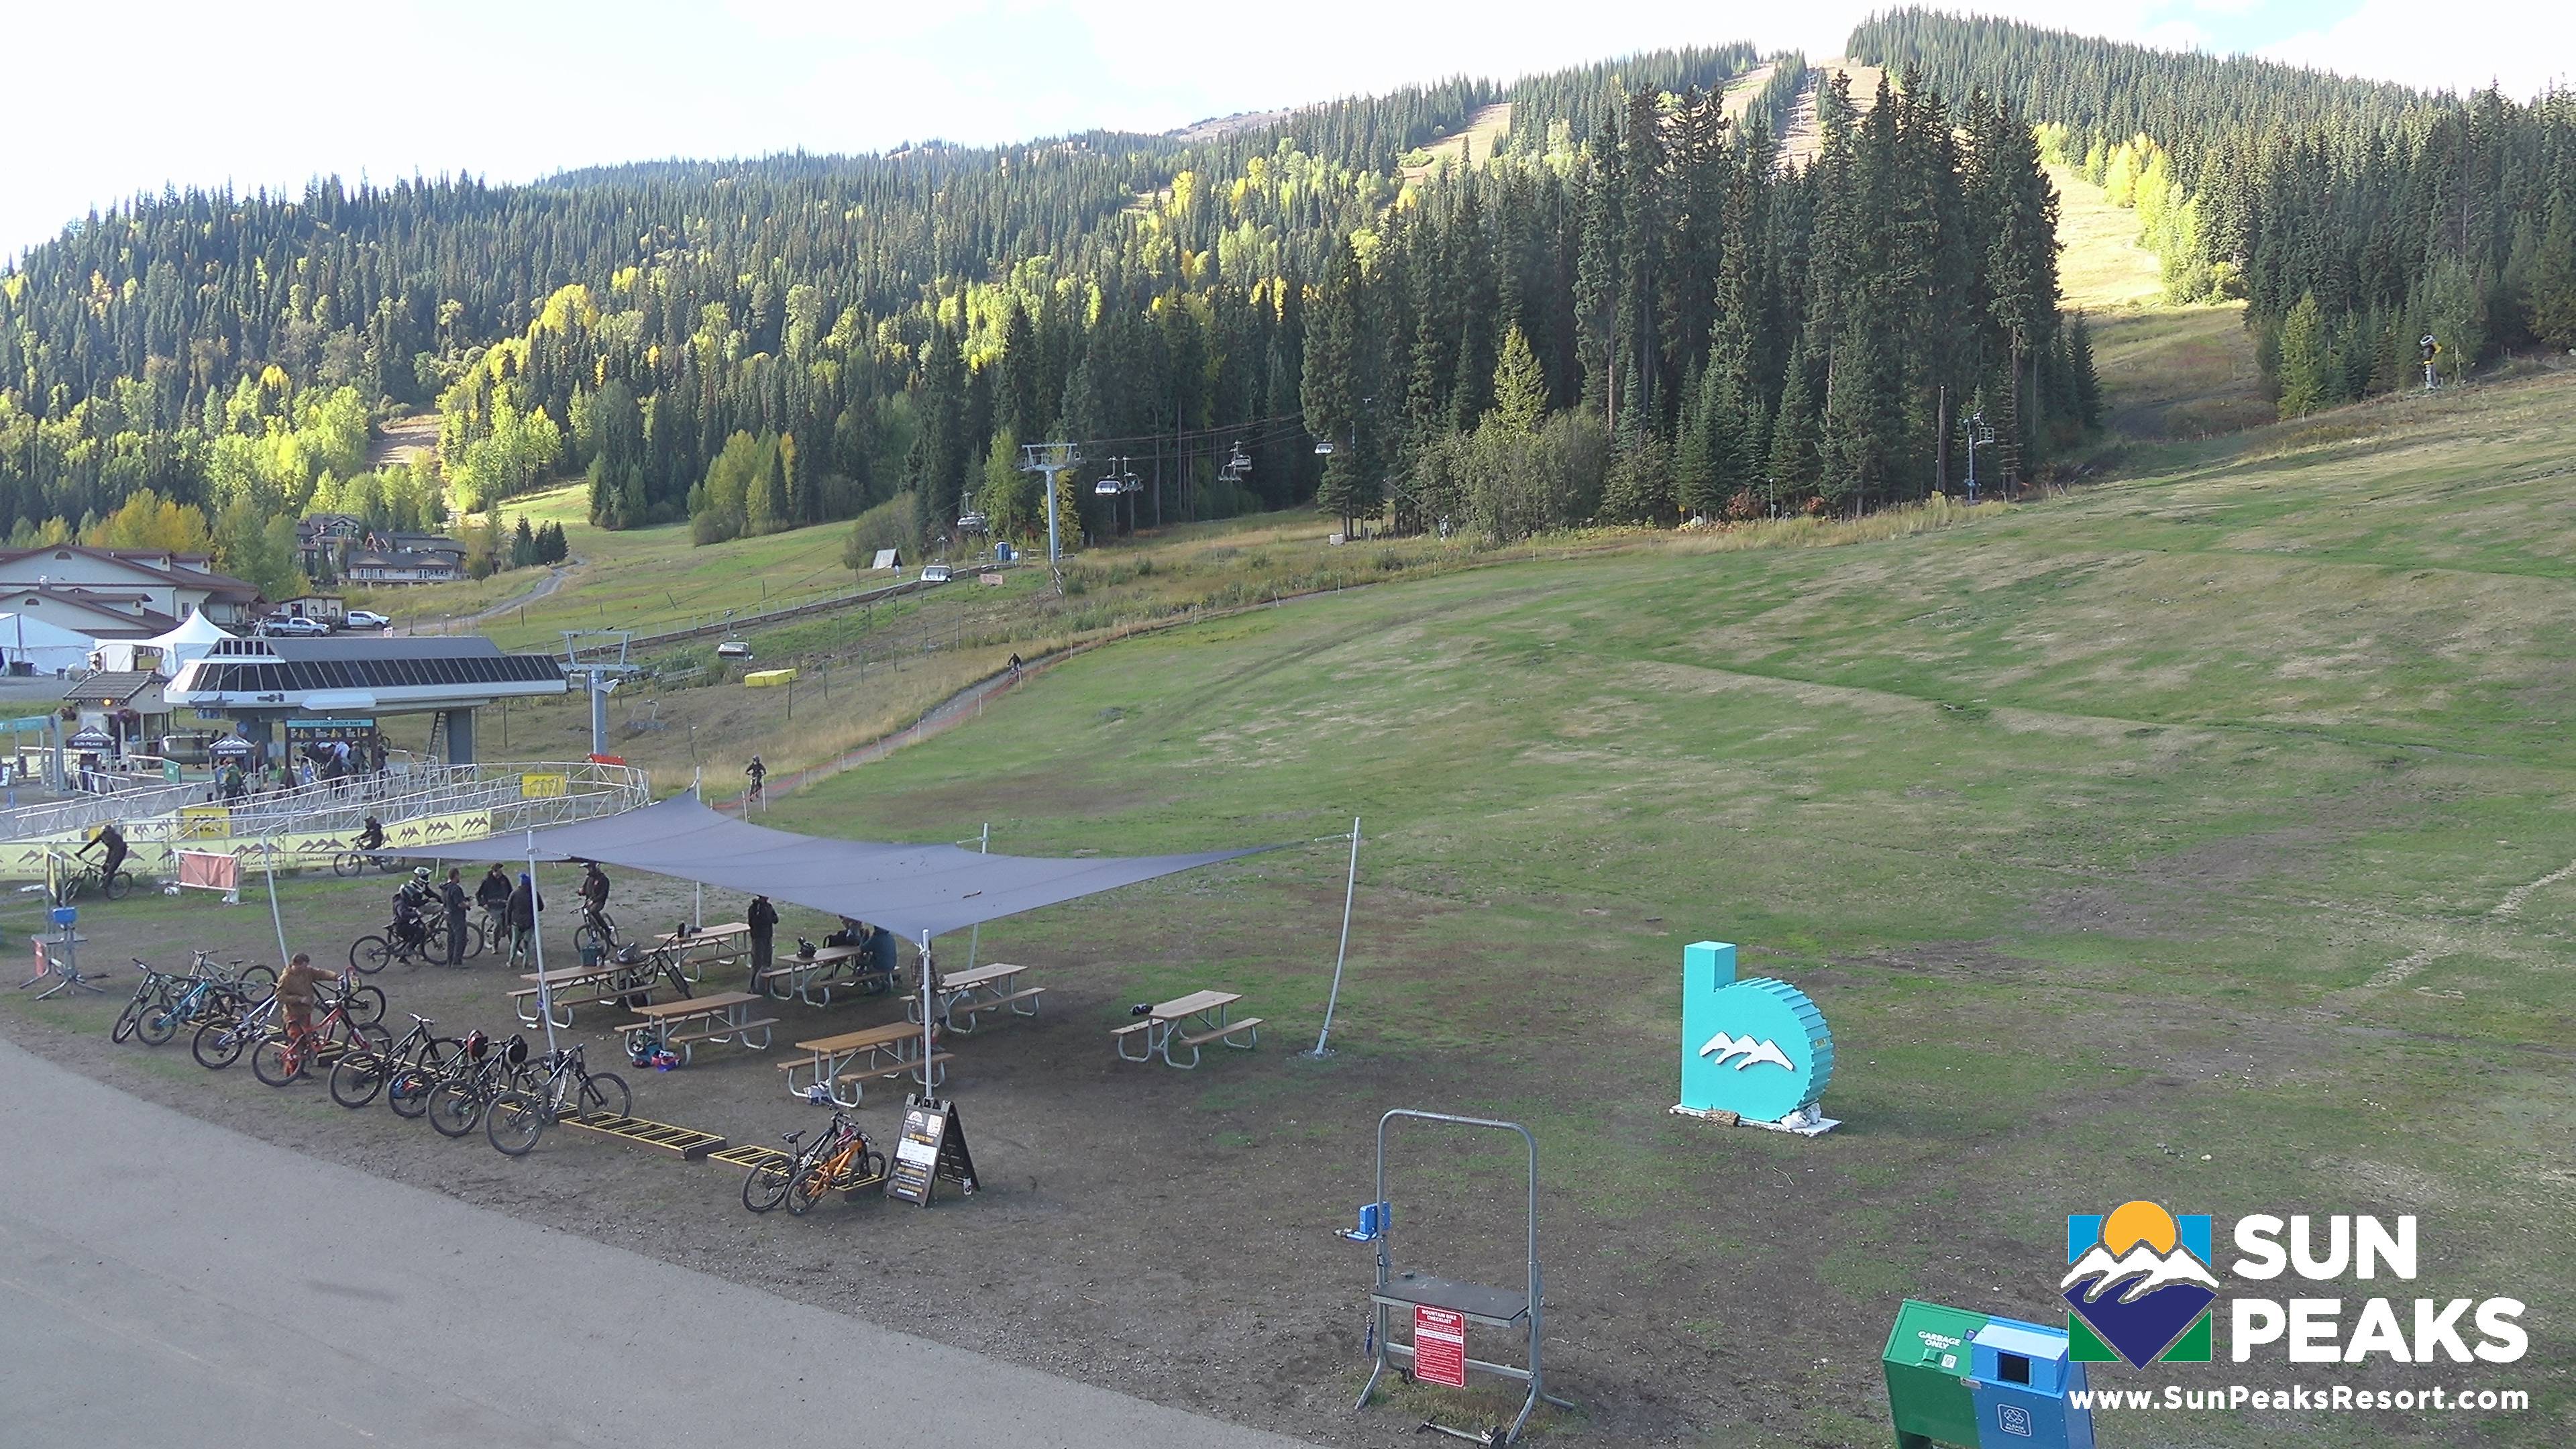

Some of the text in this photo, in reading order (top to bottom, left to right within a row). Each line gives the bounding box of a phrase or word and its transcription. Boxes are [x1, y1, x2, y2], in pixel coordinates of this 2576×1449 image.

[1421, 1309, 1446, 1318] MOUNTAIN
[1426, 1316, 1452, 1325] CHECKLIST
[1918, 1331, 1961, 1346] GARBAGE
[1924, 1338, 1949, 1350] ONLY
